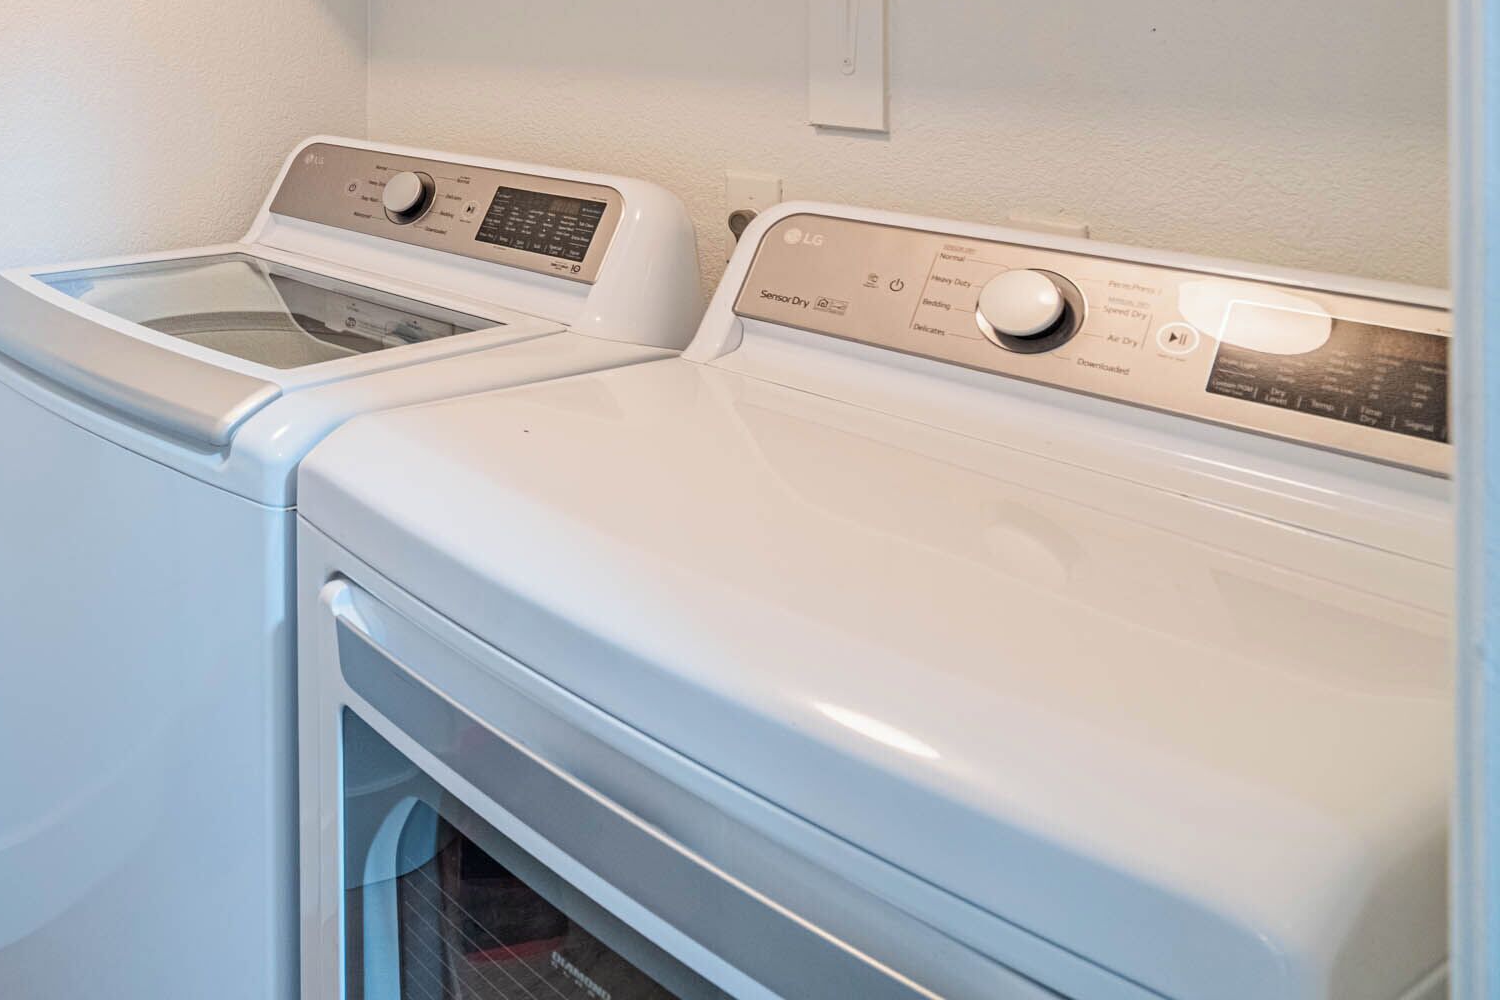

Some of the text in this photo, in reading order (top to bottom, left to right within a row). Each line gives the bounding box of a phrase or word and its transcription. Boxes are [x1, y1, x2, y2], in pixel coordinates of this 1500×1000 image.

[803, 233, 826, 247] LG
[939, 252, 966, 263] Normal
[931, 274, 973, 289] Heavy Duty
[760, 289, 810, 309] Sensor Dry
[922, 298, 952, 311] Bedding
[1103, 304, 1148, 321] Speed Dry
[913, 322, 946, 337] Delicates
[1107, 333, 1138, 348] Air Dry
[1076, 357, 1130, 376] Downloaded
